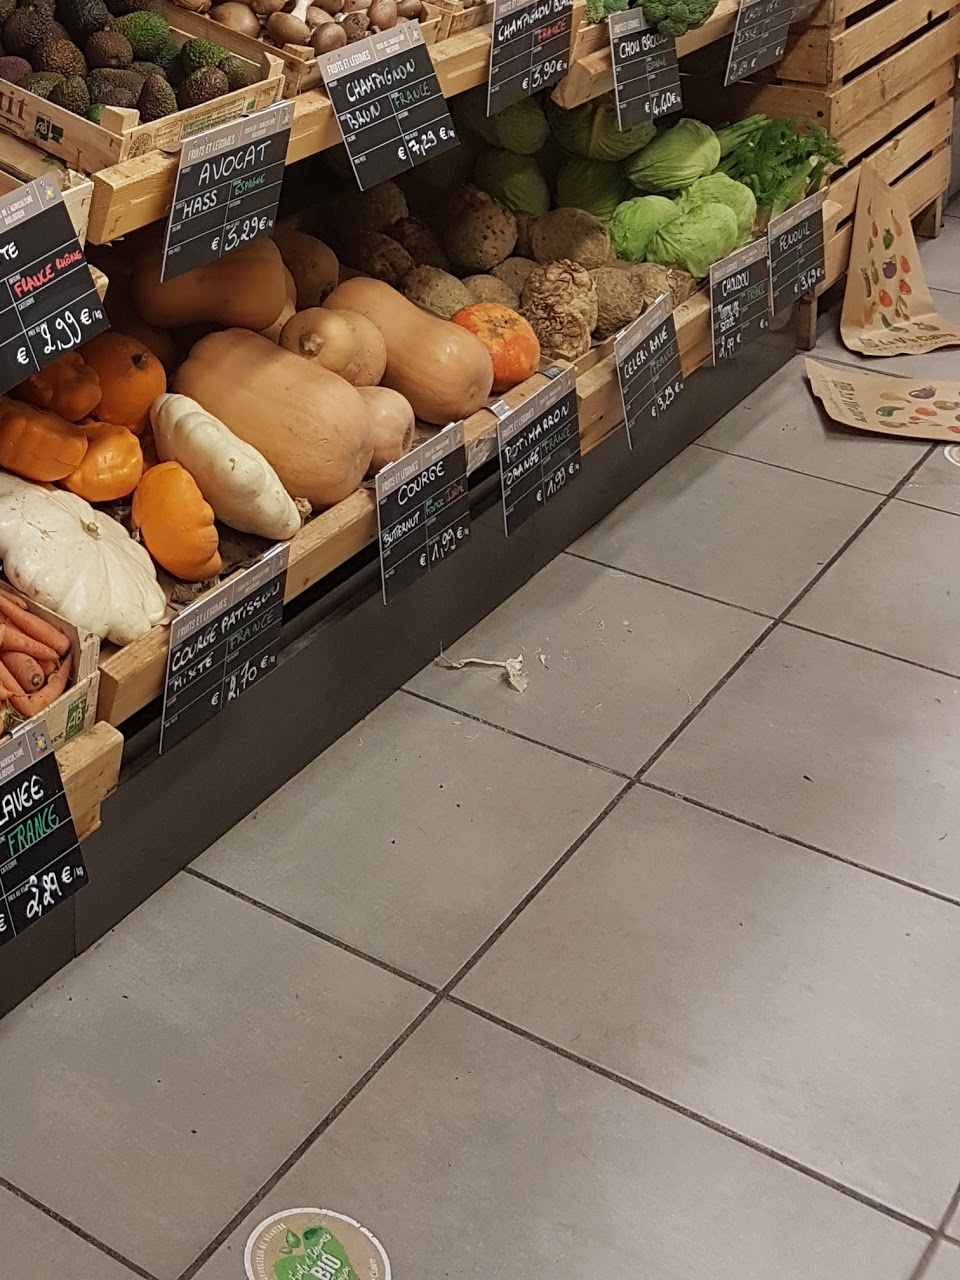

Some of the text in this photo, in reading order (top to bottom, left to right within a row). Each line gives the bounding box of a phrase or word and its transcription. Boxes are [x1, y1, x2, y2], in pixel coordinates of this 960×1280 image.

[537, 19, 566, 42] FRANCE
[620, 40, 640, 58] CHOU
[346, 59, 416, 102] CHAMPIGNON
[393, 82, 431, 108] FRANCE
[346, 101, 381, 130] BRUN
[653, 92, 672, 115] 4,40
[408, 131, 437, 156] 7,29
[199, 140, 271, 186] AVOCAT
[235, 173, 266, 196] ESPAGNE
[182, 190, 218, 219] HASS
[43, 310, 82, 354] 2,99
[649, 325, 668, 354] RAVE
[506, 447, 539, 485] ORANGE
[397, 461, 445, 506] COURGE
[383, 511, 420, 548] BUTTERNUT
[230, 610, 274, 651] FRANCE
[172, 623, 218, 672] COURGE
[7, 803, 59, 856] FRANCE
